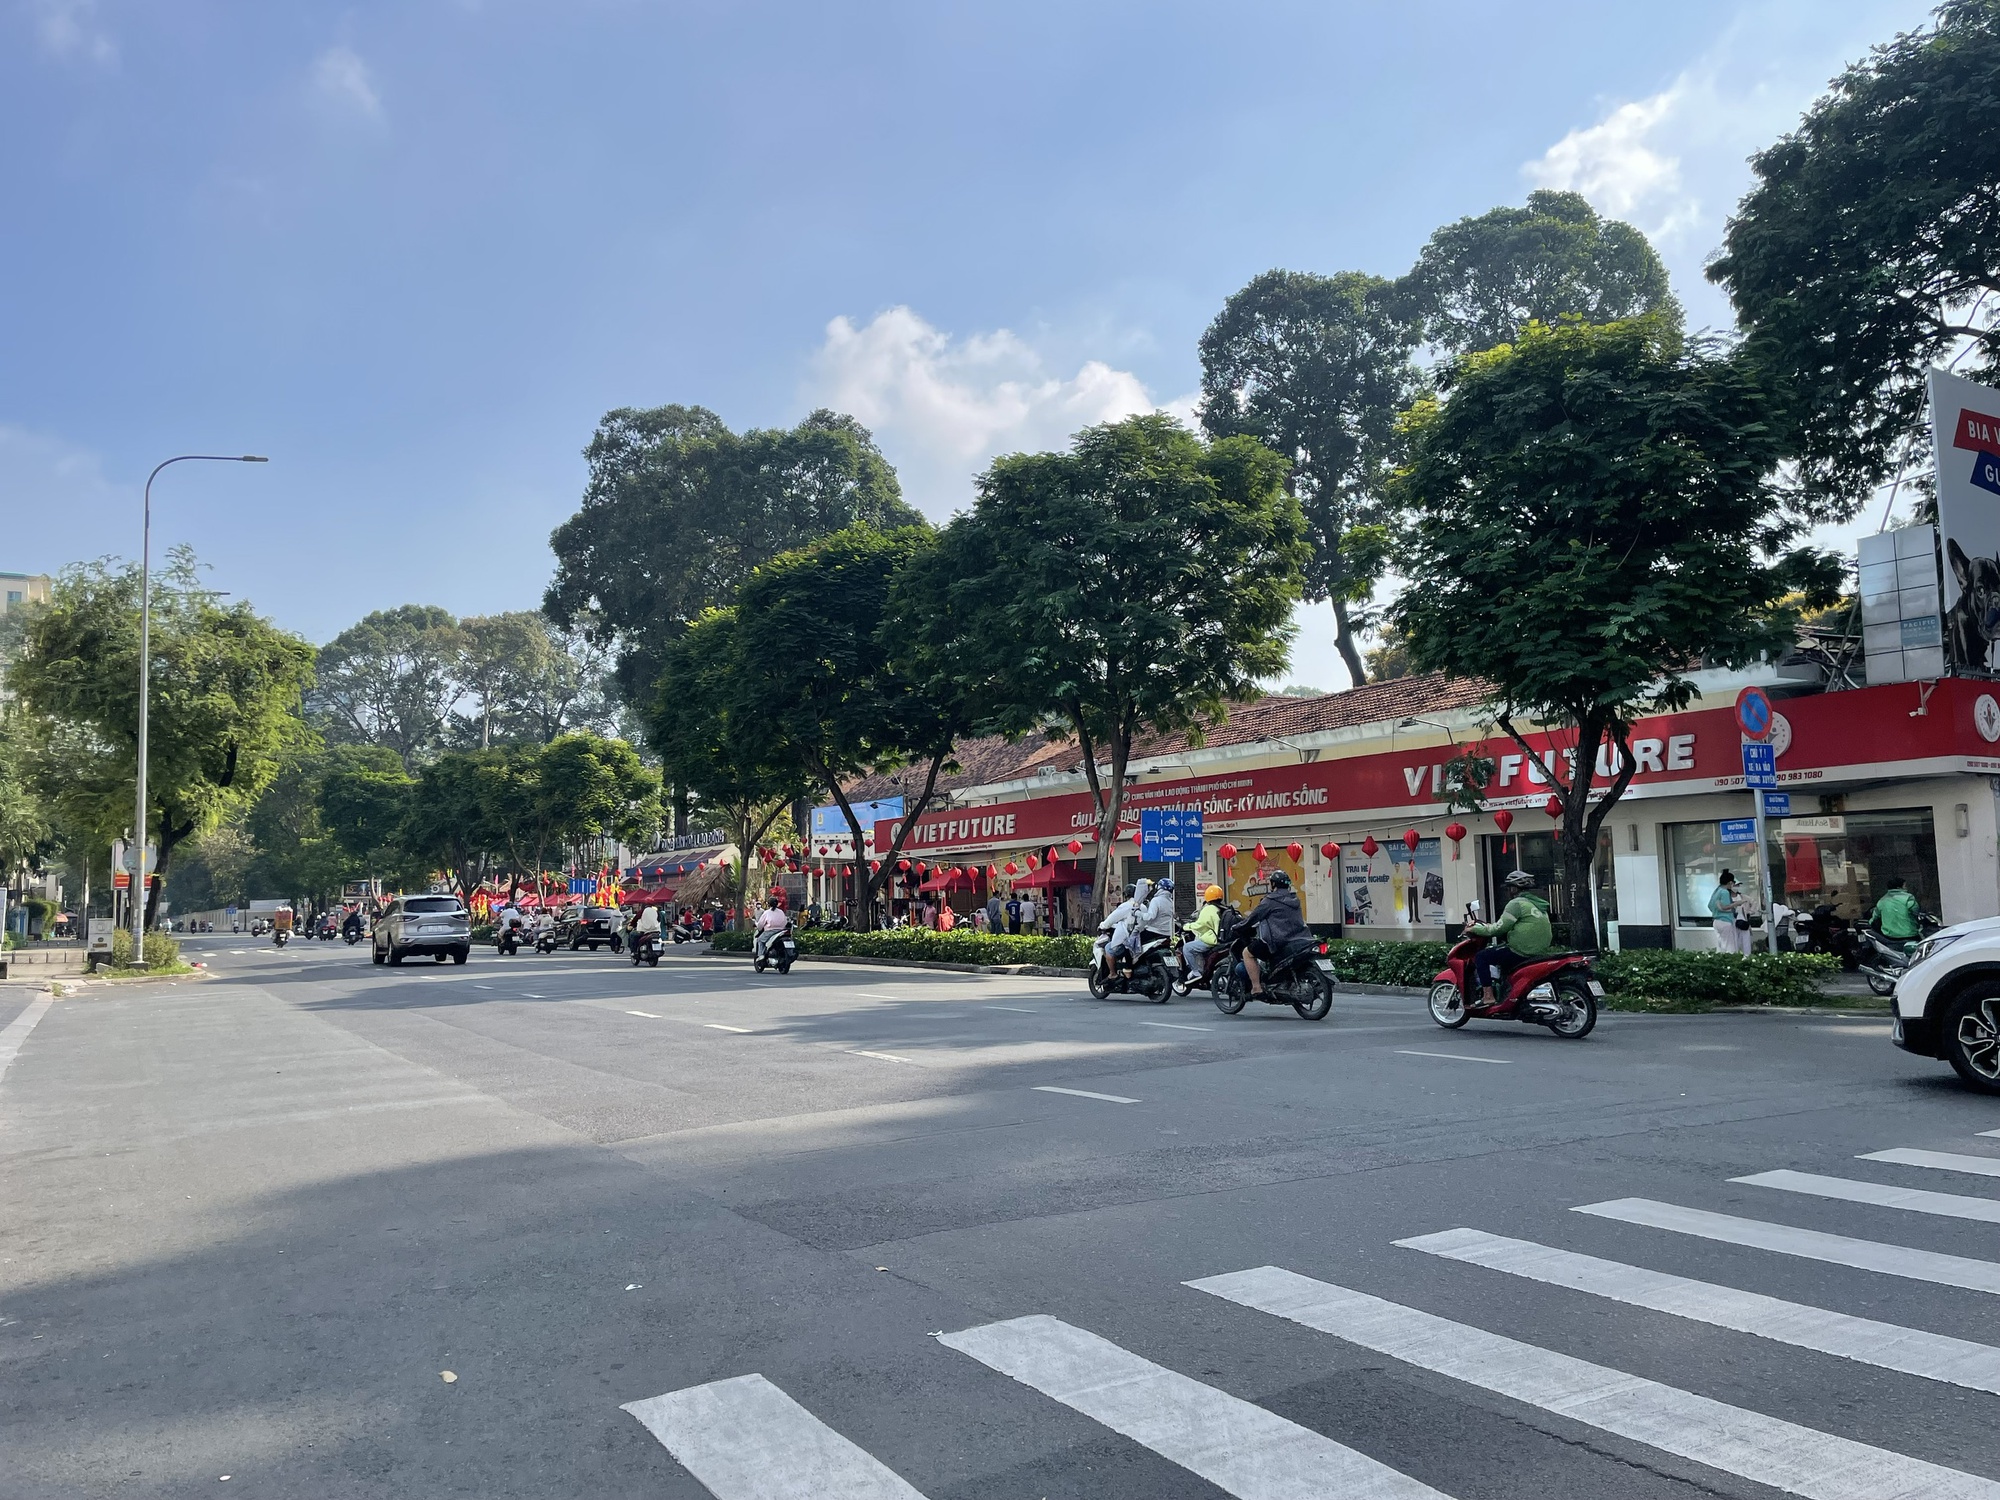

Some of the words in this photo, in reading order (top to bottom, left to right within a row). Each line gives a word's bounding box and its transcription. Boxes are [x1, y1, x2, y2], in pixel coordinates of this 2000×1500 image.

[1968, 420, 1991, 443] BIA
[1903, 619, 1936, 628] PACIFIC
[1730, 777, 1744, 786] 507
[1788, 772, 1802, 780] 983
[1804, 770, 1823, 779] 1080
[1120, 806, 1140, 822] ĐÀO
[1293, 783, 1328, 807] SỐNG
[913, 813, 1016, 844] VIETFUTURE
